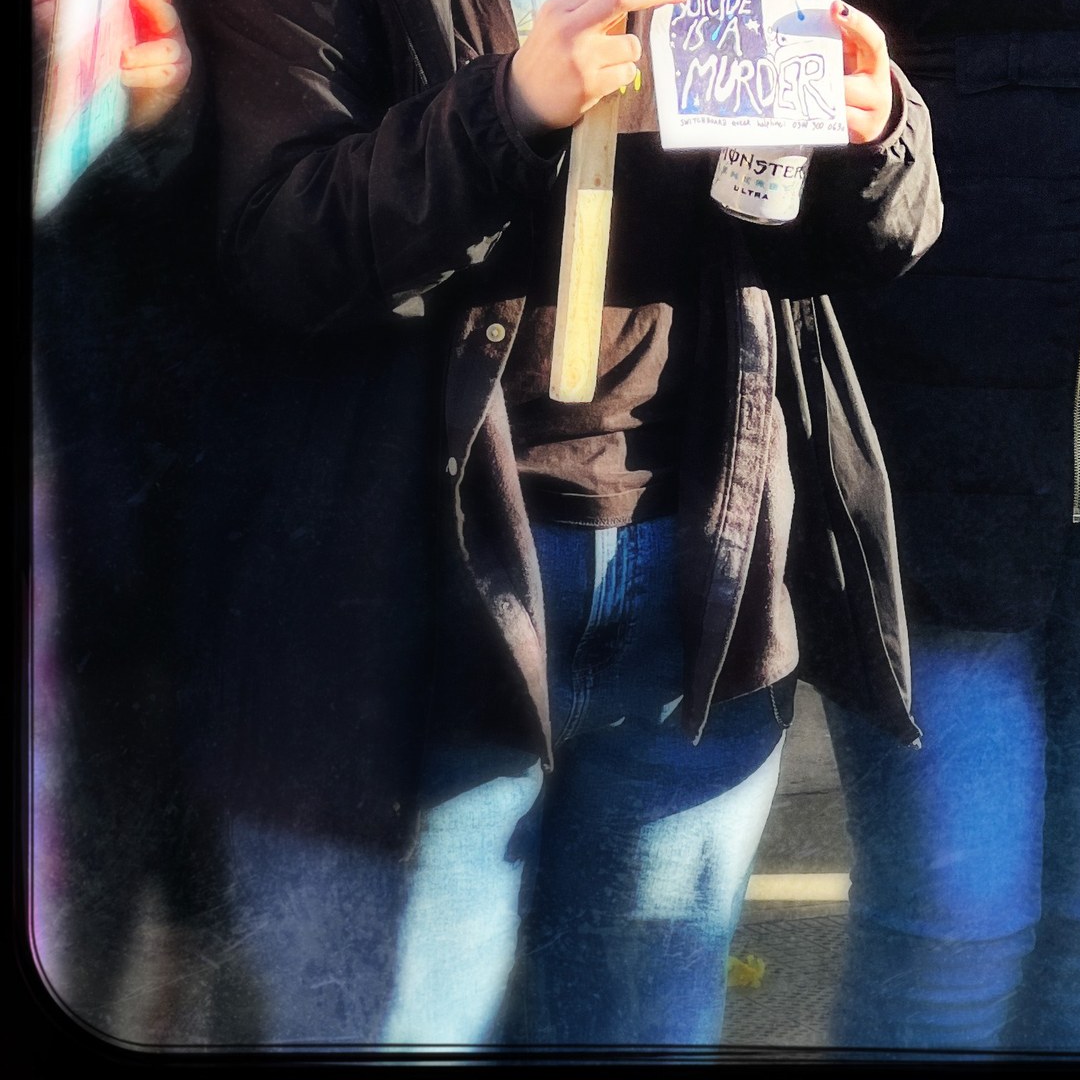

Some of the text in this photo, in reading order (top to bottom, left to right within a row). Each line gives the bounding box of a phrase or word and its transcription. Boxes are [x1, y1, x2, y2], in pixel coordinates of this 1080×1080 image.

[682, 16, 743, 57] IS A
[681, 54, 837, 120] MURDER
[733, 184, 769, 201] ULTRA
